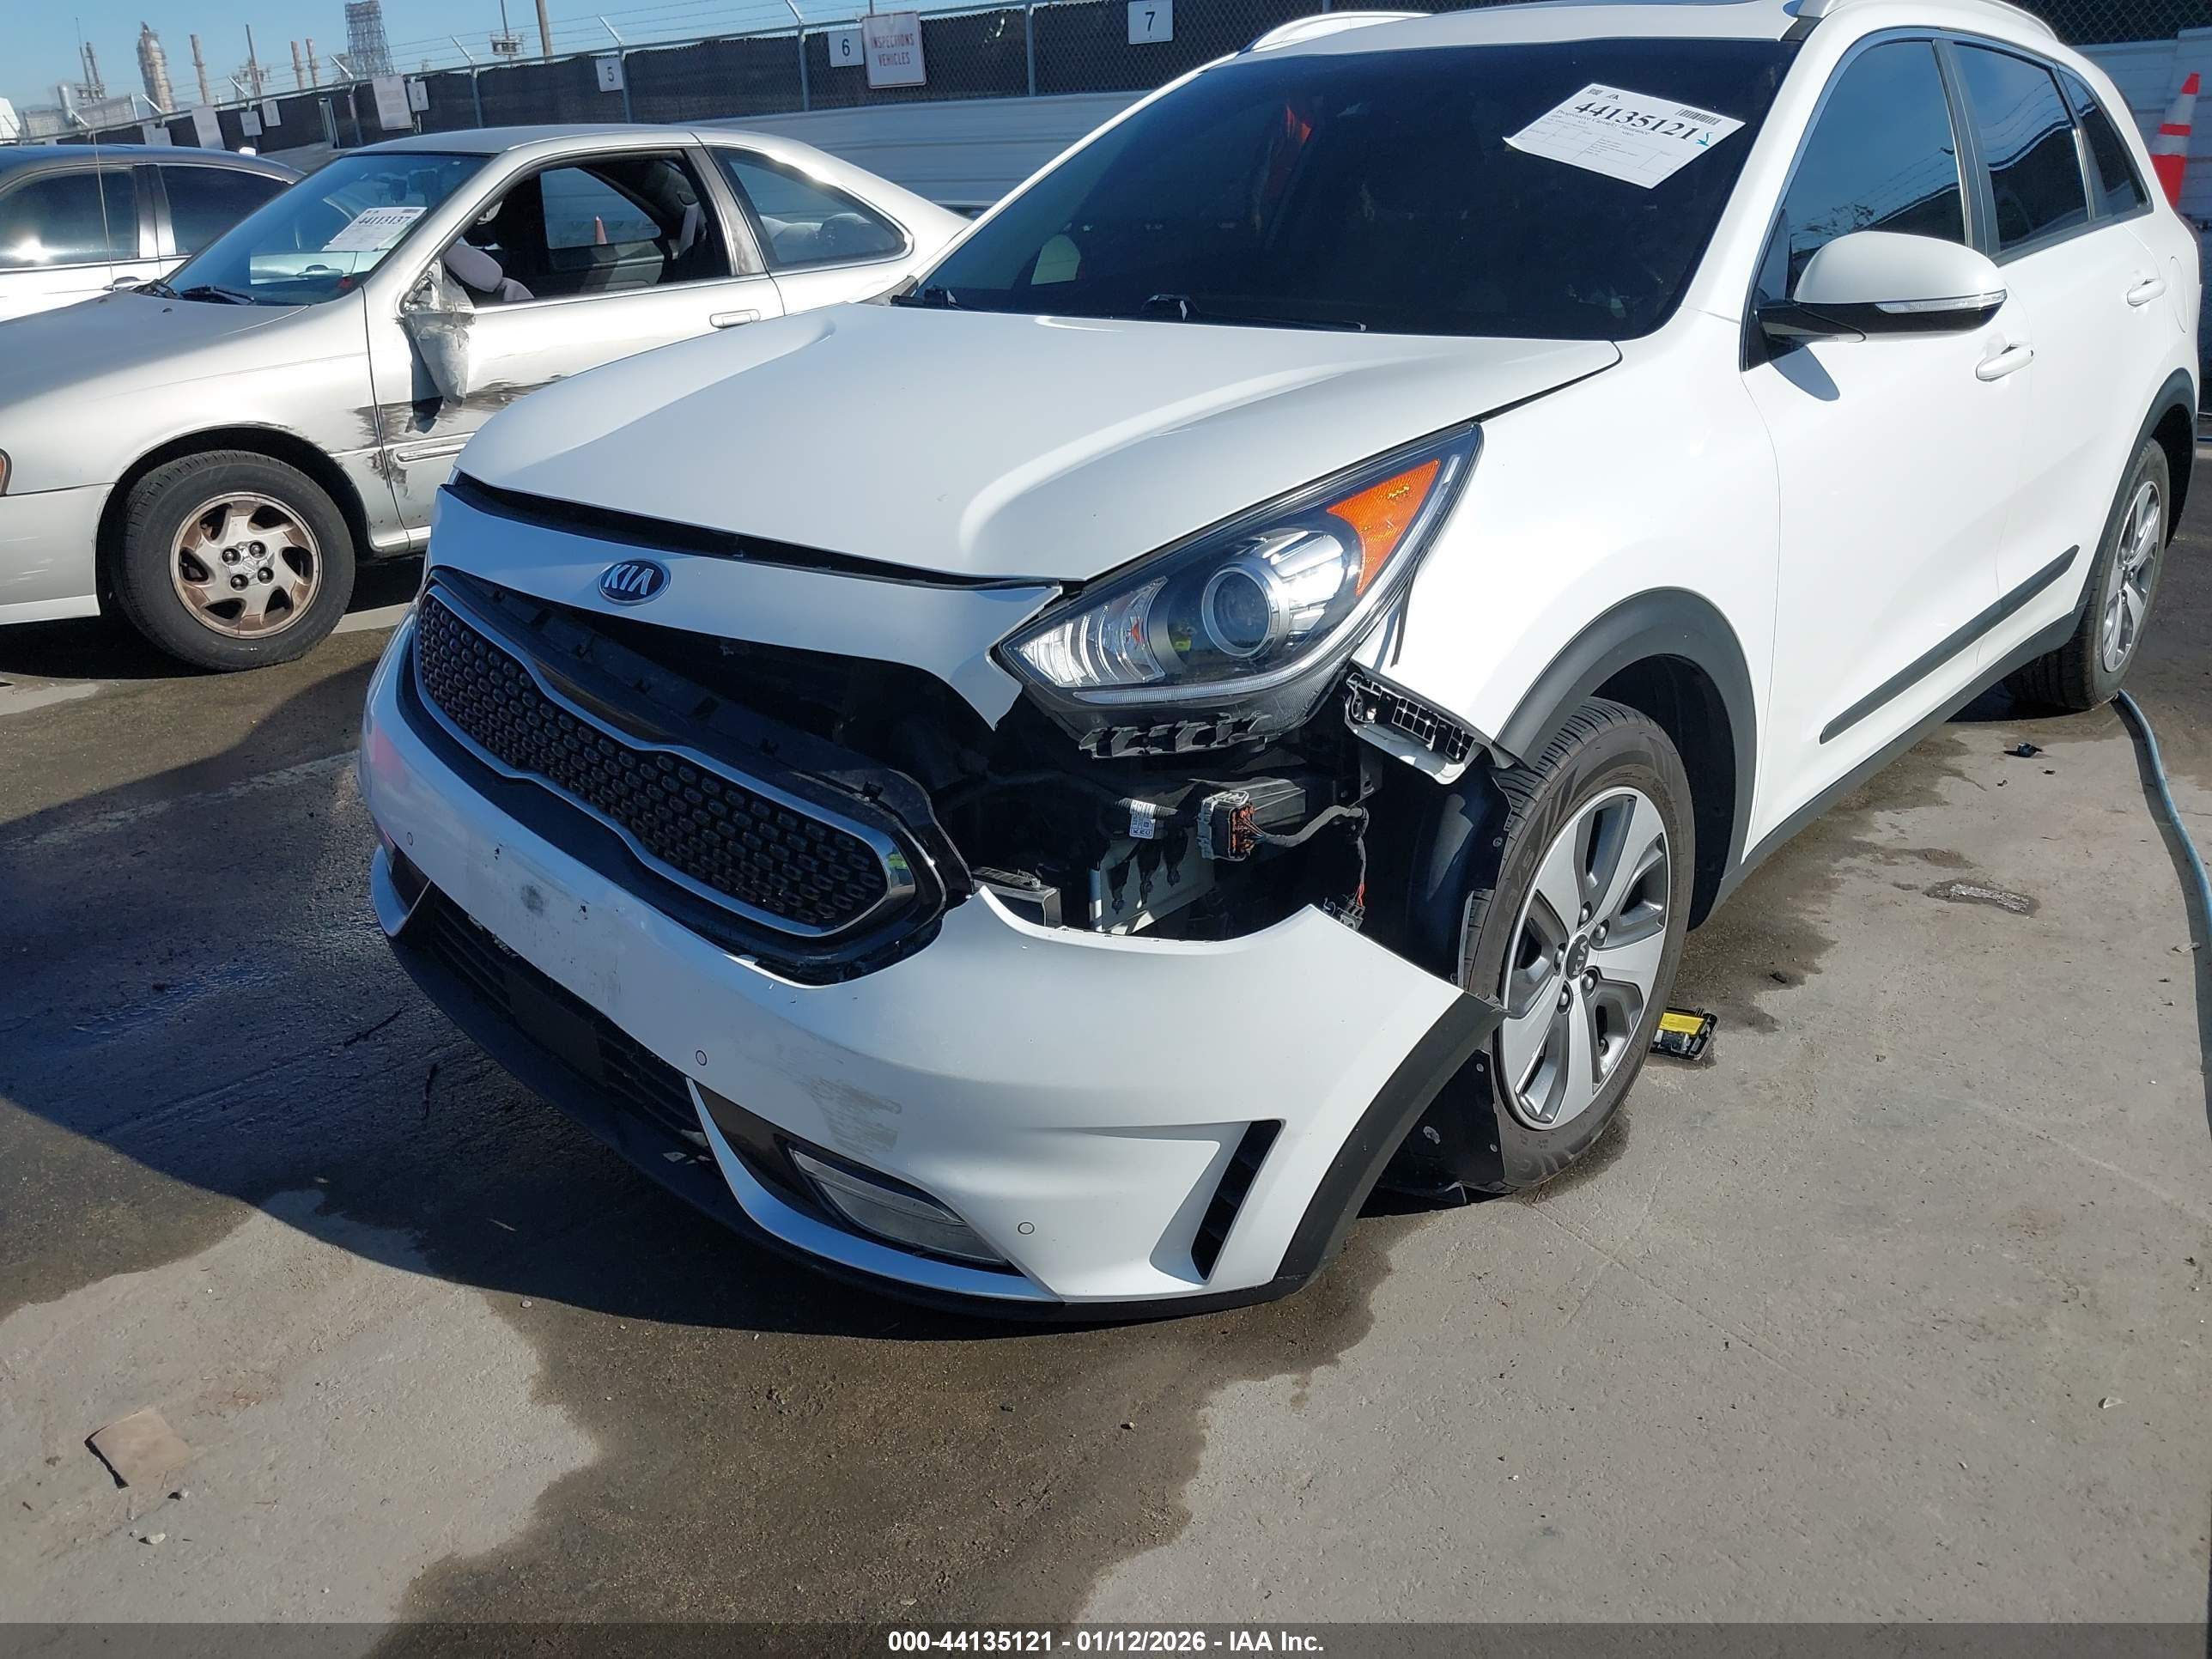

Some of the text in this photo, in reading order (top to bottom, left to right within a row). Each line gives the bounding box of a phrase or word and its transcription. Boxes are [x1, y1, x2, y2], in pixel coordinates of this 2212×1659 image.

[1146, 11, 1156, 32] 7
[842, 38, 851, 57] 6
[871, 33, 915, 49] INSPECTIONS
[878, 52, 911, 67] VEHICLES
[607, 66, 615, 82] 5
[1573, 101, 1700, 141] 44135121
[604, 563, 655, 595] KIA
[1572, 940, 1589, 976] KIA
